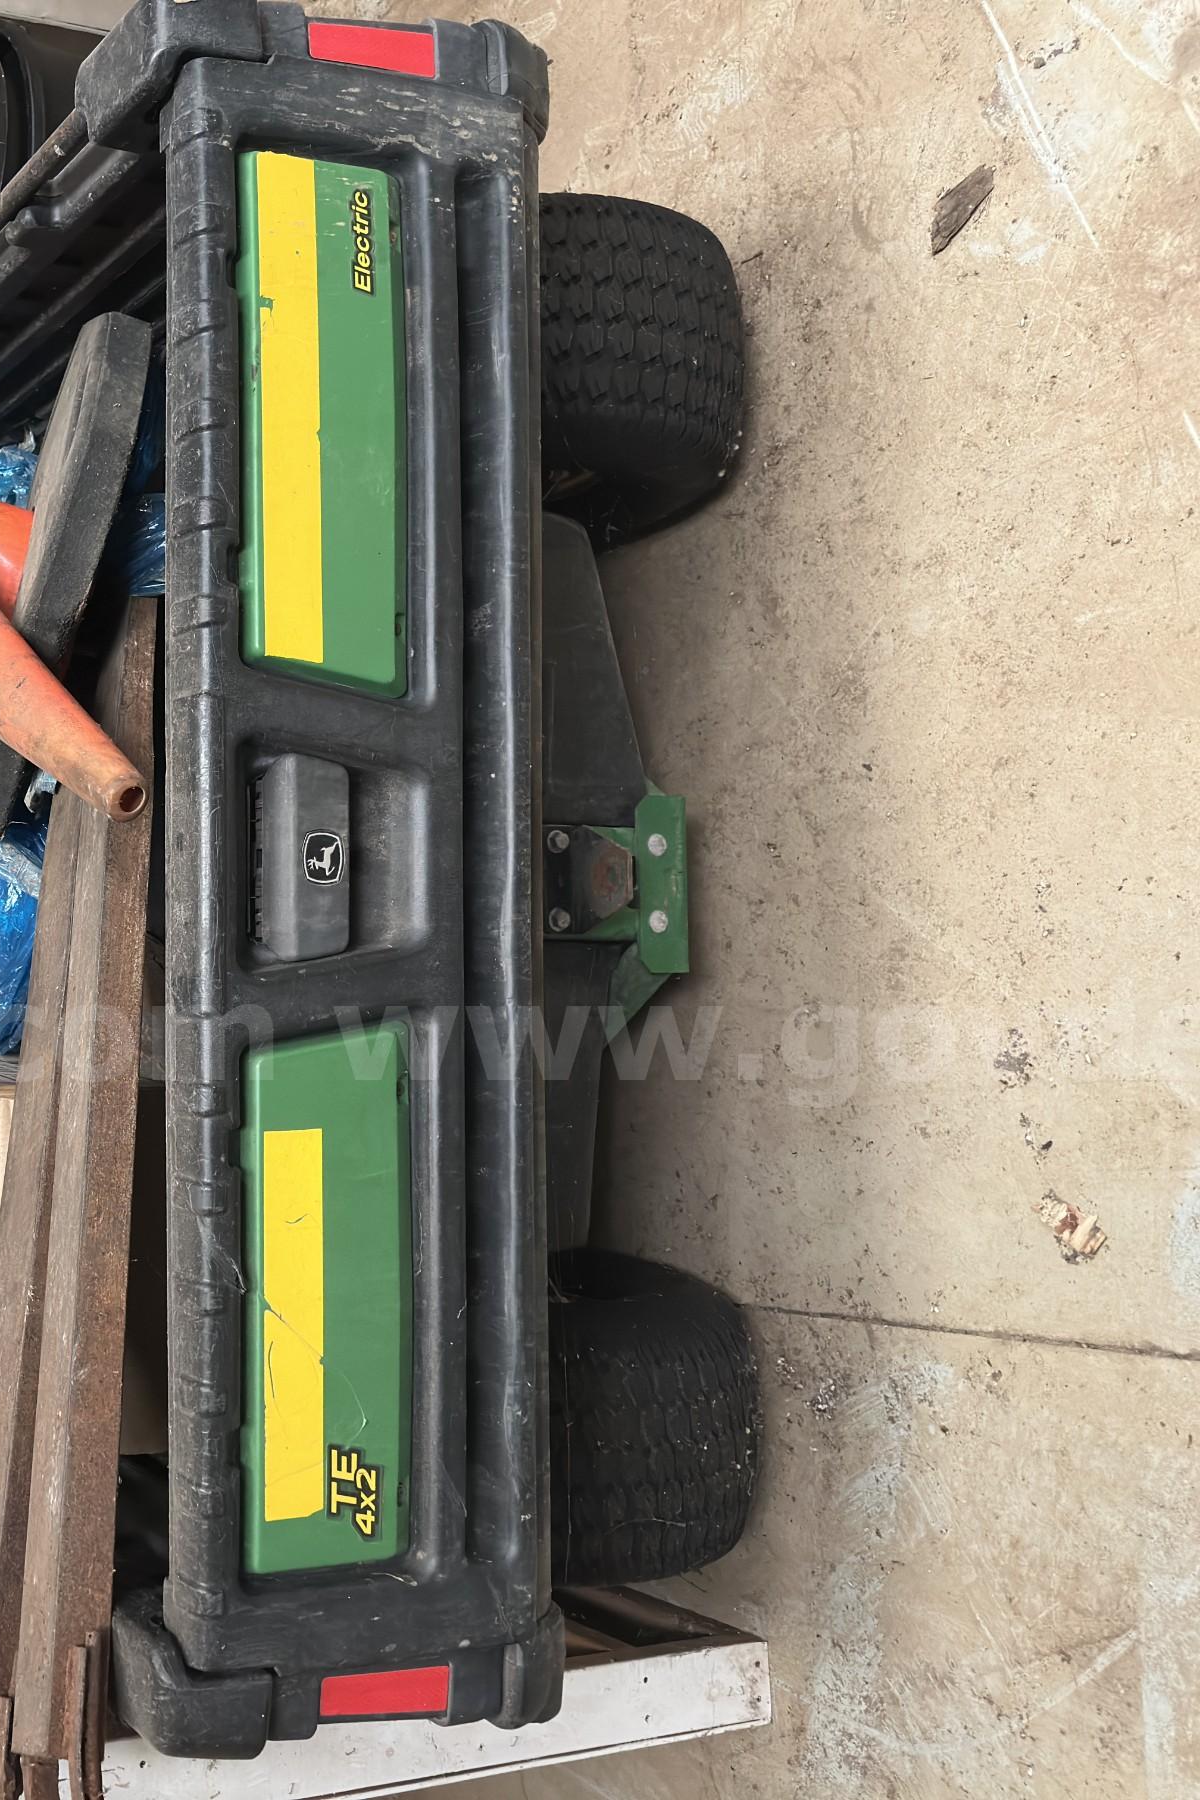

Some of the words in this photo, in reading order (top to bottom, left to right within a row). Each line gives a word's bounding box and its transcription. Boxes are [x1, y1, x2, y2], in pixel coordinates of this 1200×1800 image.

[351, 191, 371, 293] Electric
[331, 1449, 358, 1514] TE
[355, 1468, 376, 1535] 4x2
